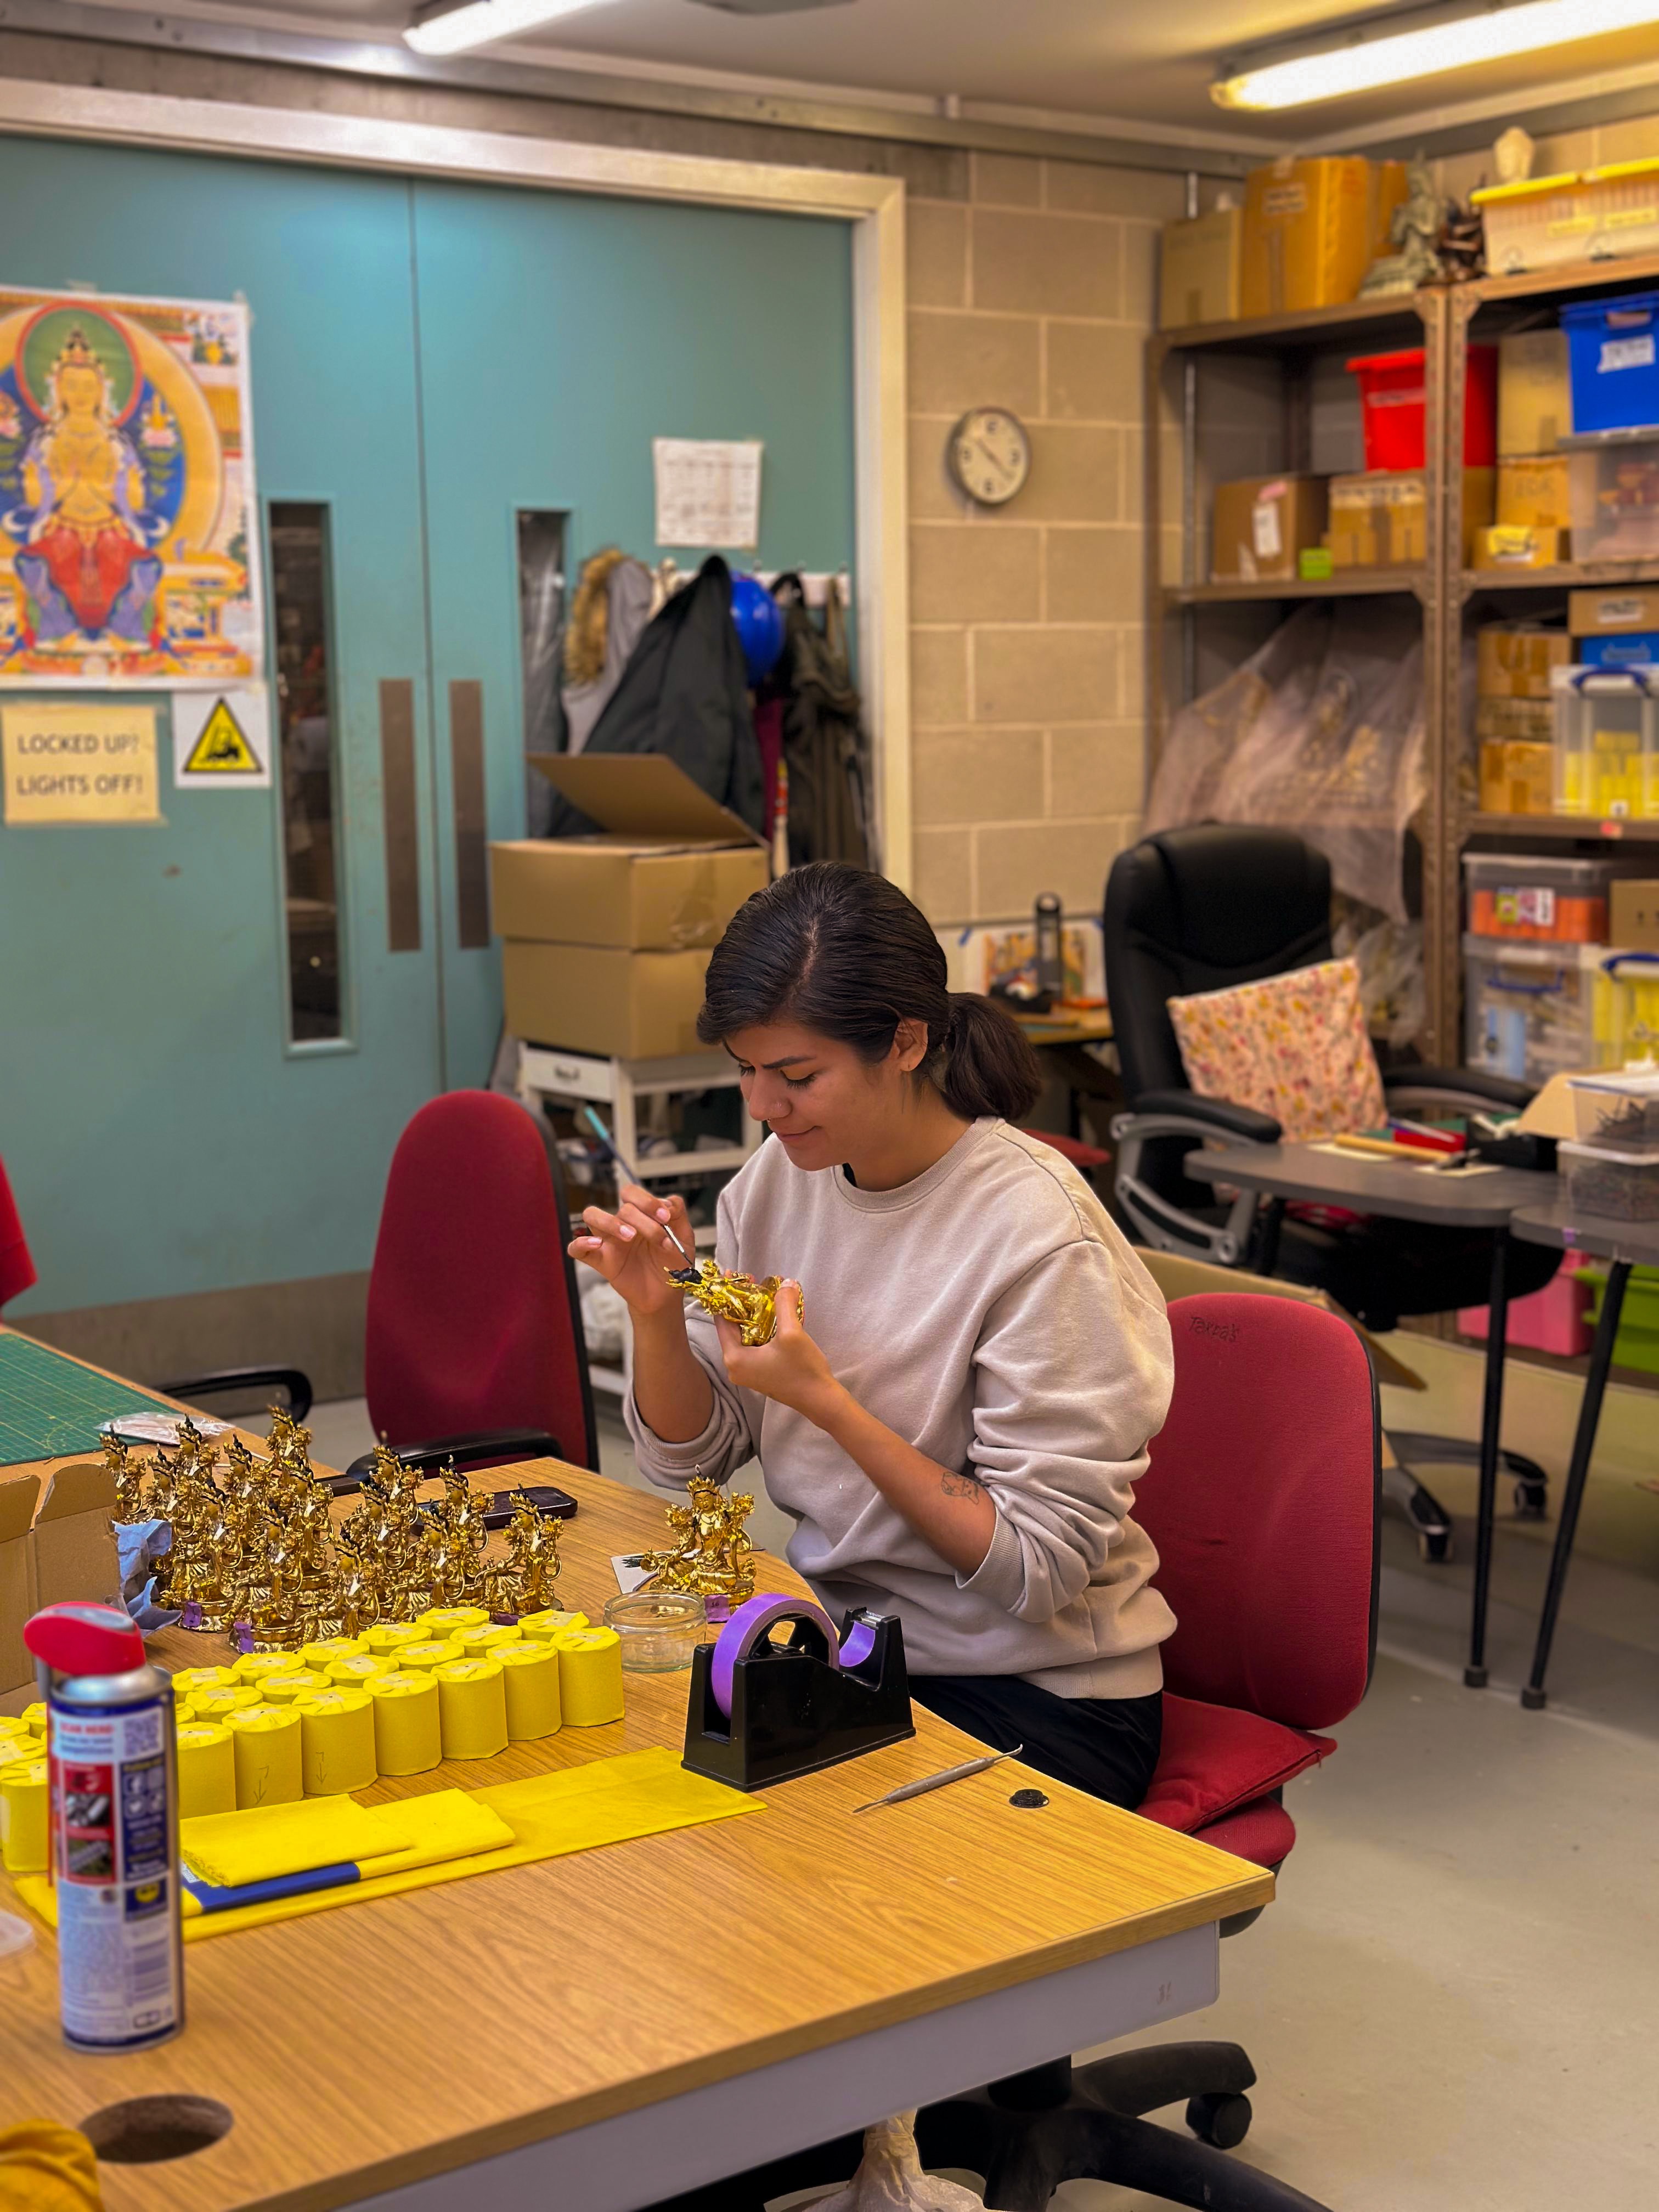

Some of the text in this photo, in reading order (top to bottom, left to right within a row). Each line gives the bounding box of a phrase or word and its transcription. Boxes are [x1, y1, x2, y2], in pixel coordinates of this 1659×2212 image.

[16, 733, 99, 754] LOCKED
[16, 774, 143, 795] LIGHTS OFF!
